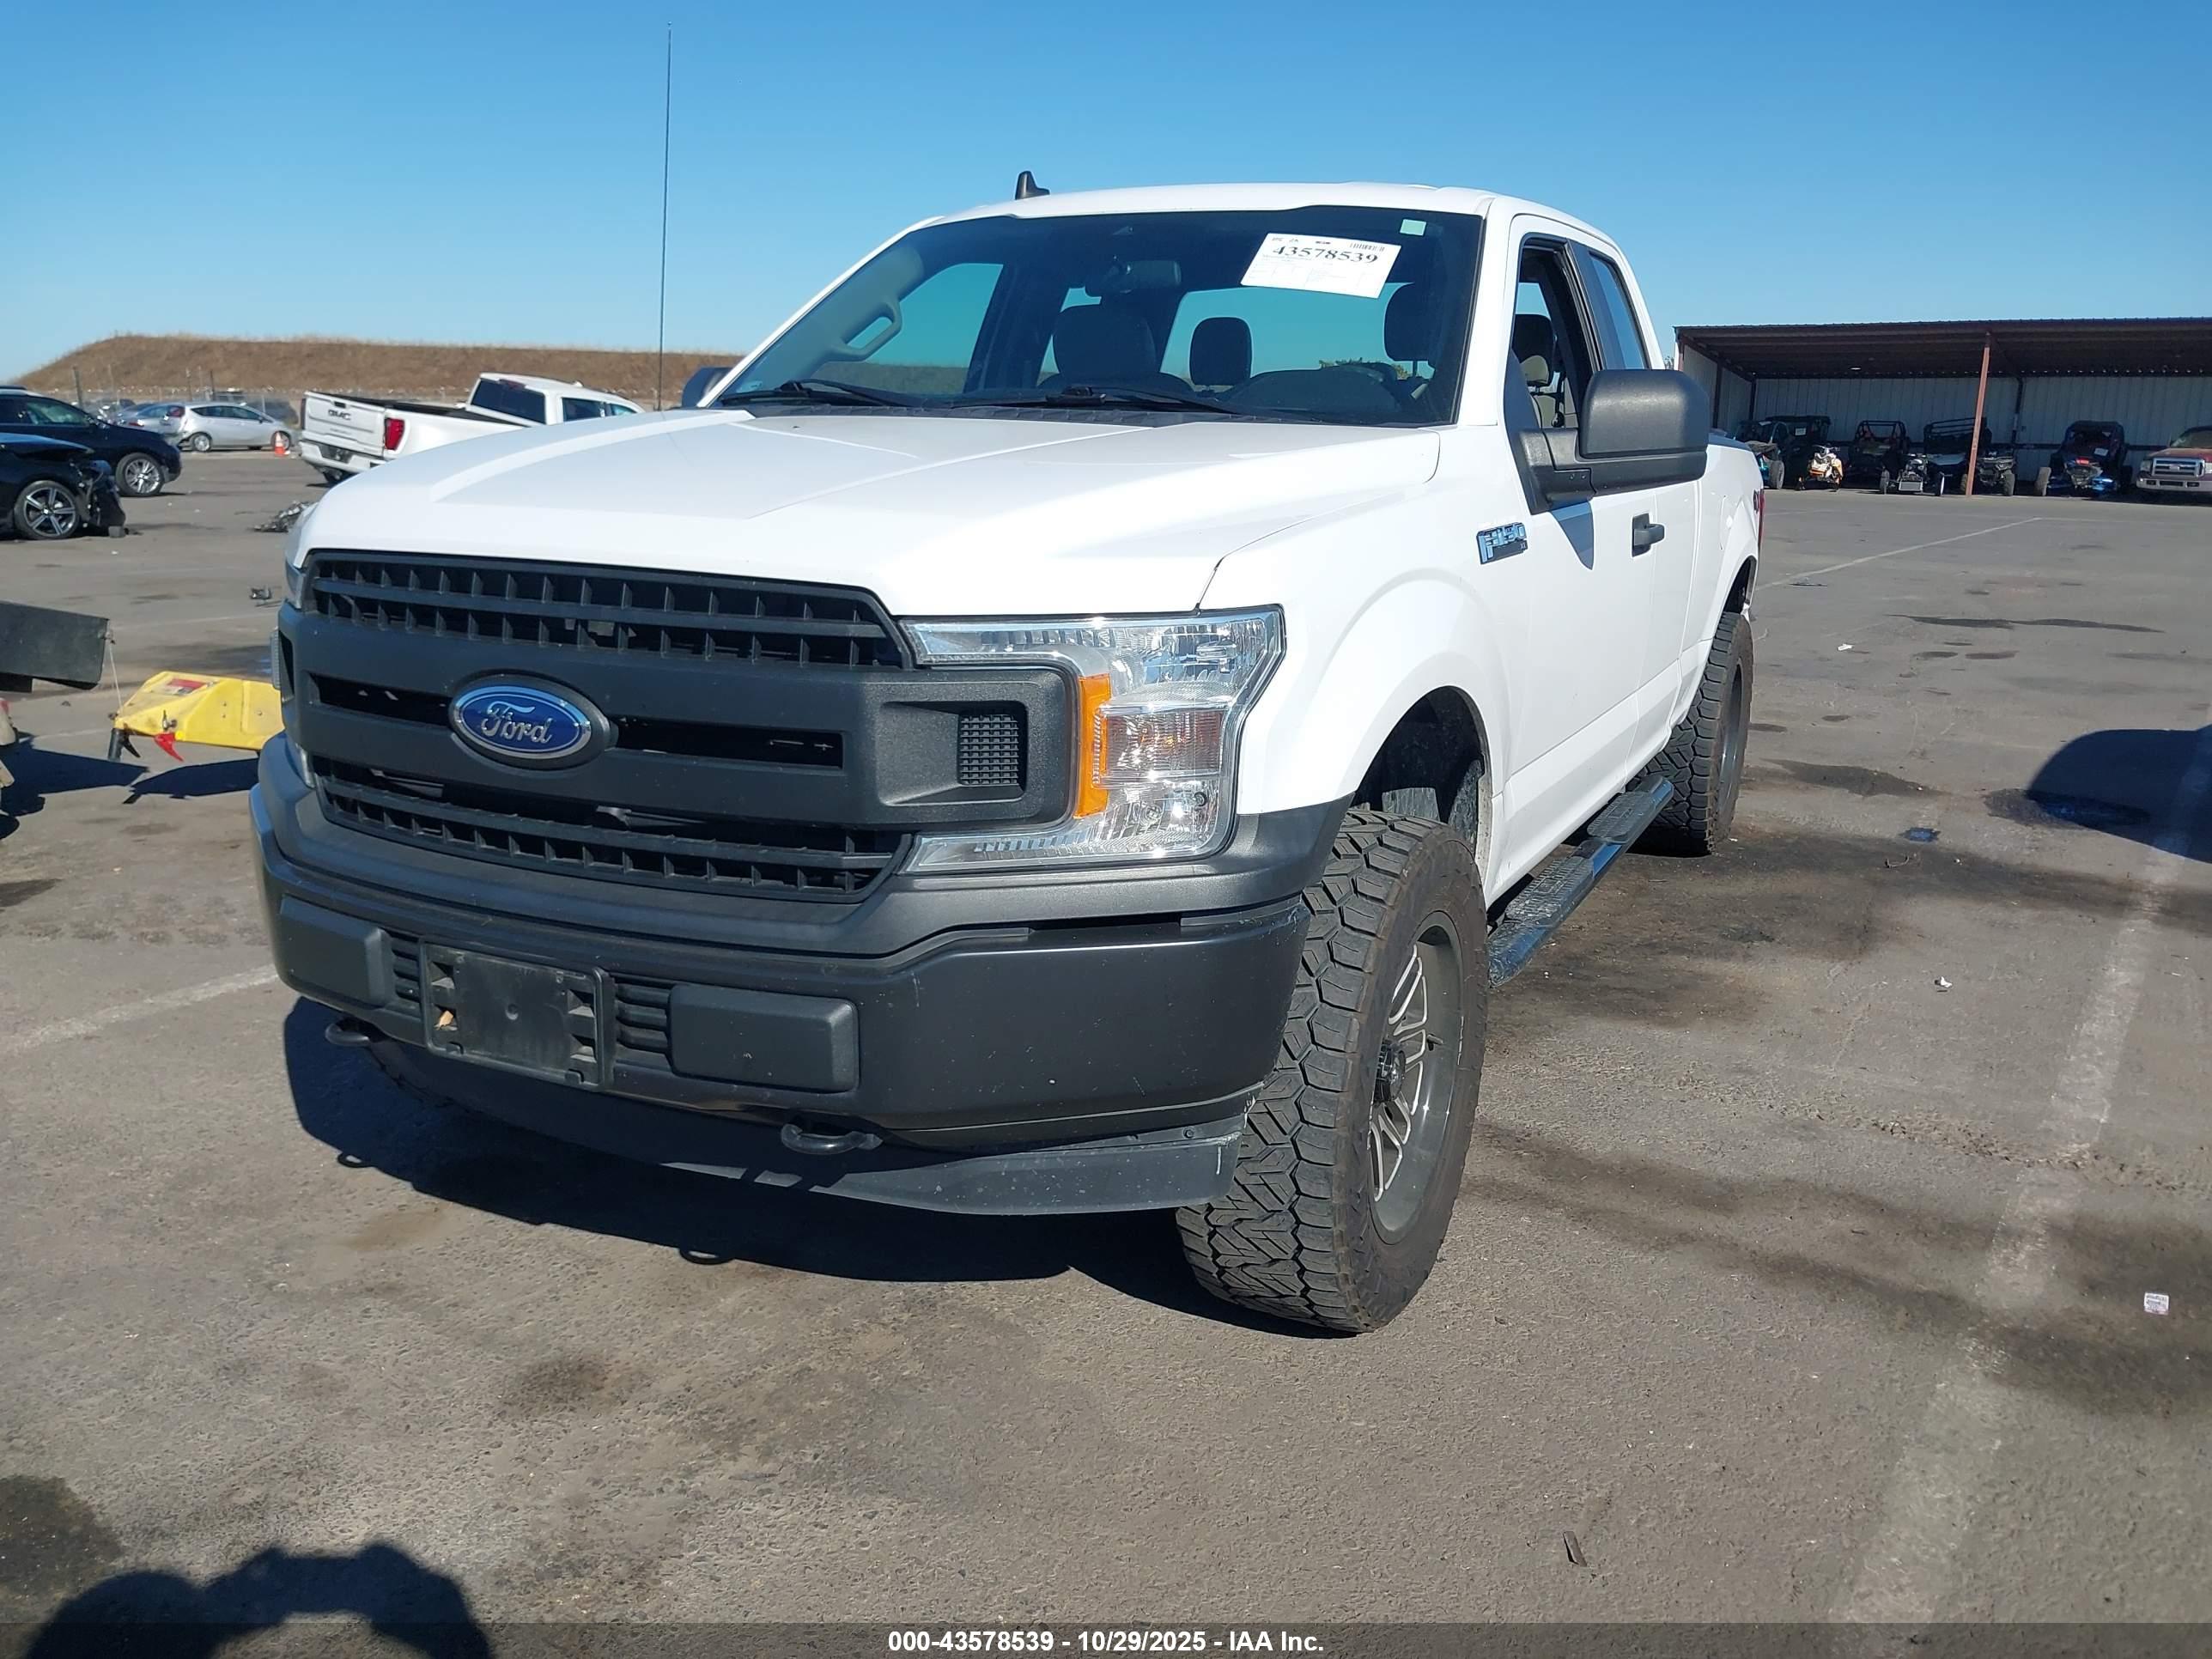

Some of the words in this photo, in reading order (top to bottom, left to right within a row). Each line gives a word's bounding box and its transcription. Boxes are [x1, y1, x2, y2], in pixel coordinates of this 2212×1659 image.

[1273, 246, 1378, 264] 43578539
[328, 409, 351, 421] GMC
[481, 700, 556, 744] Ford
